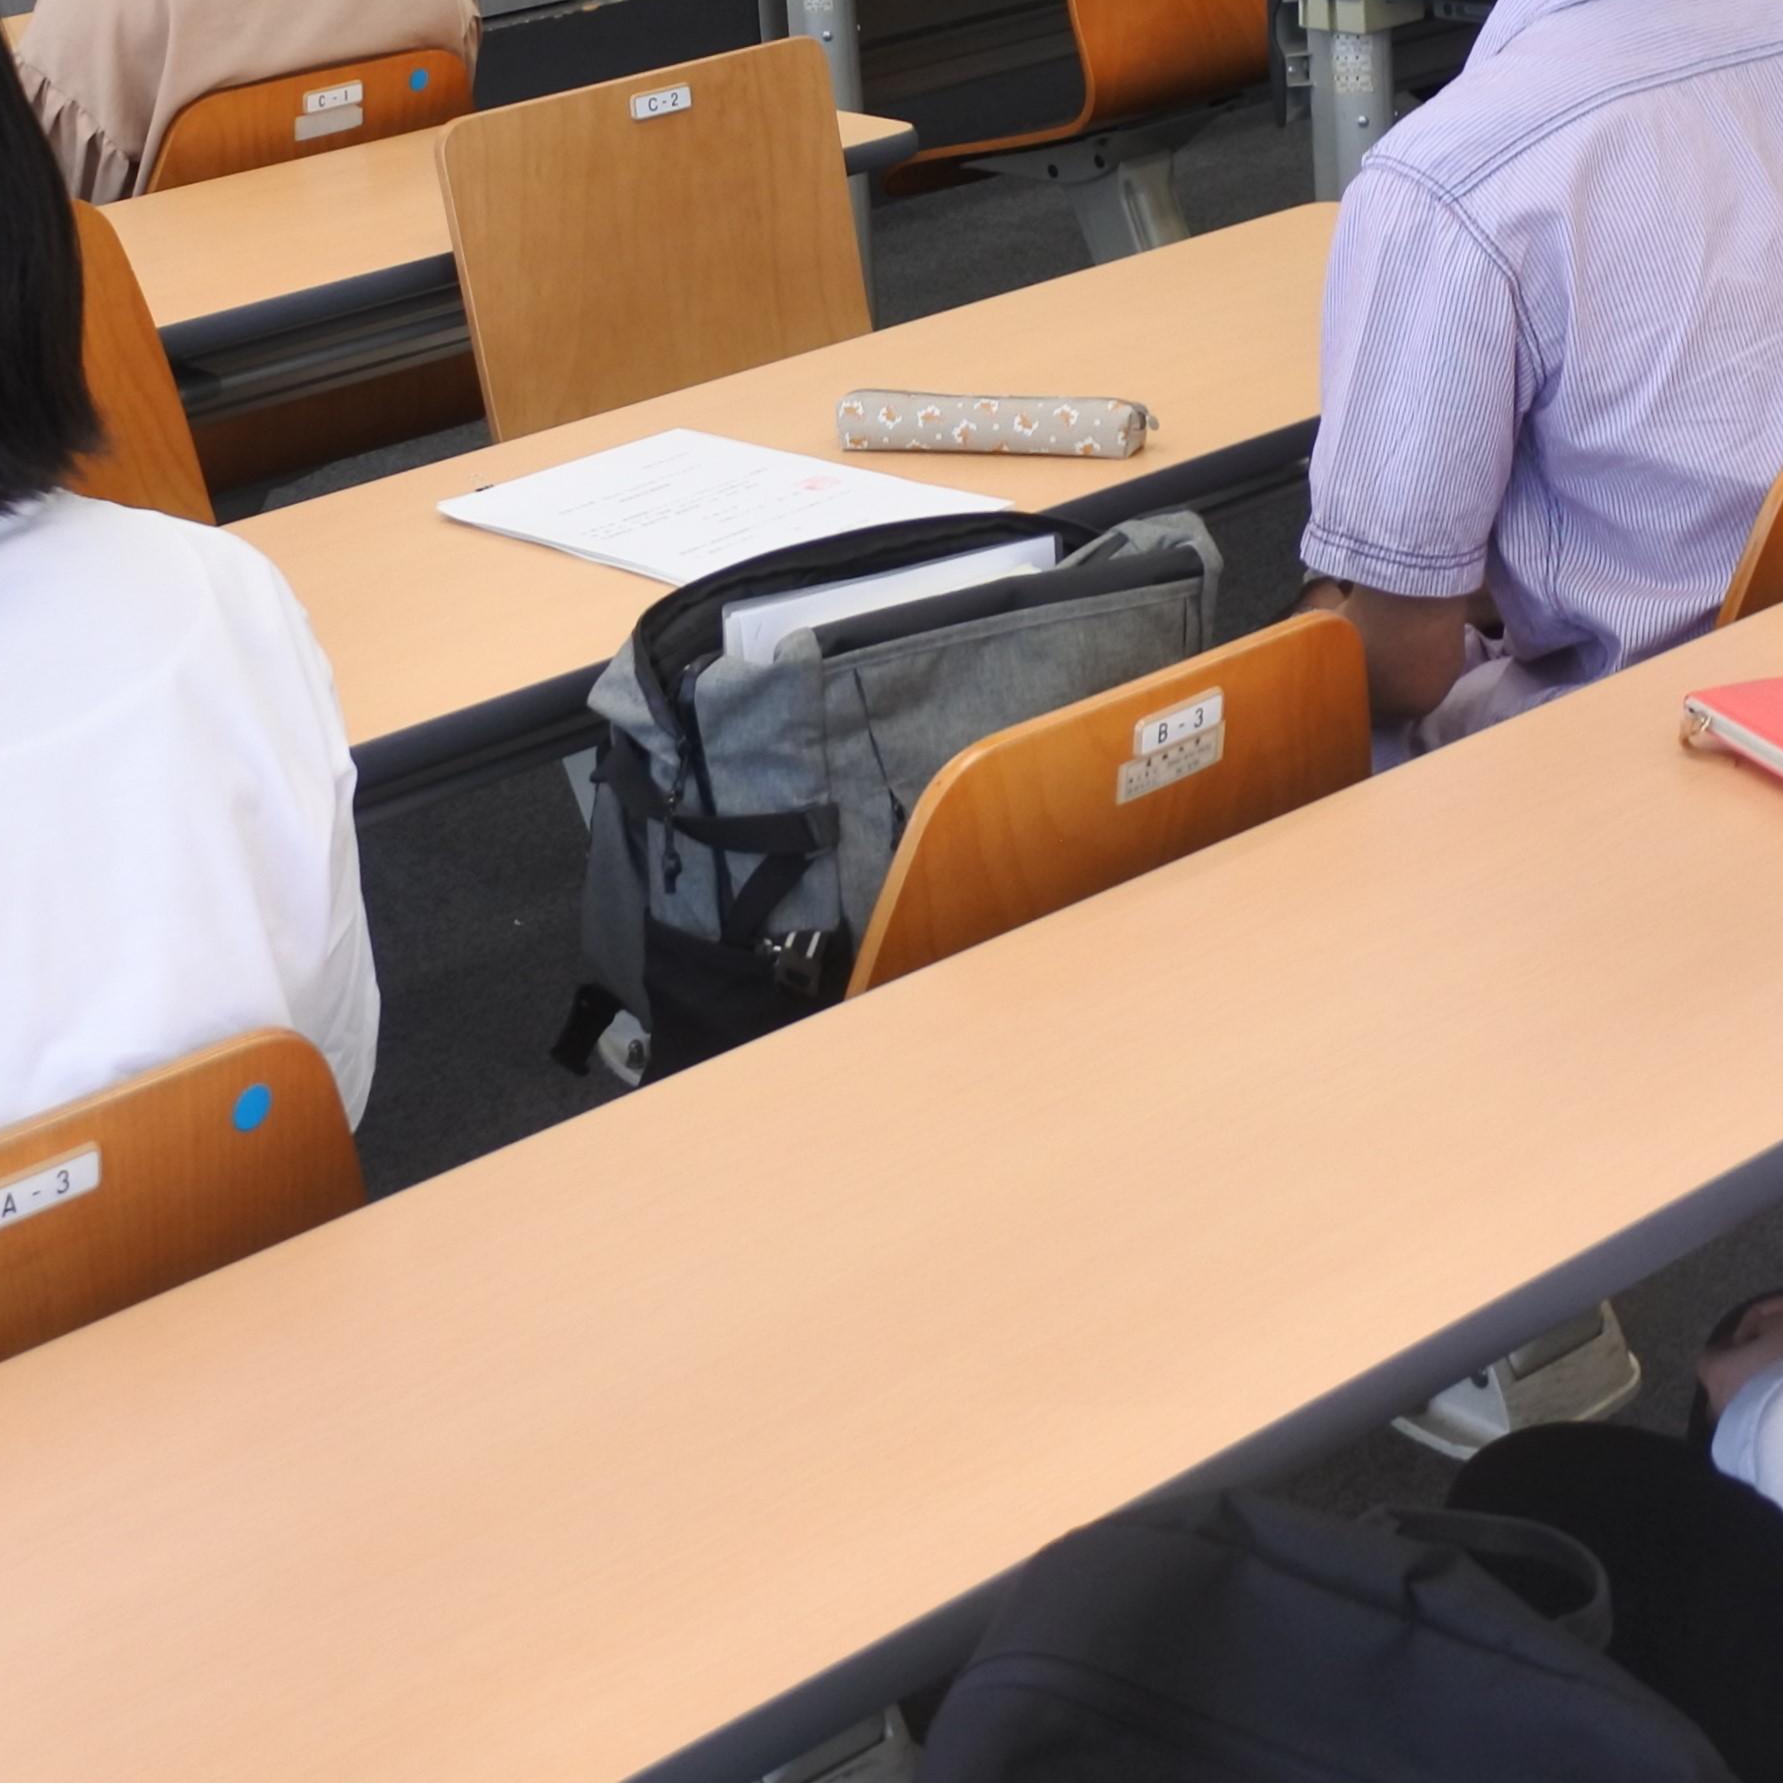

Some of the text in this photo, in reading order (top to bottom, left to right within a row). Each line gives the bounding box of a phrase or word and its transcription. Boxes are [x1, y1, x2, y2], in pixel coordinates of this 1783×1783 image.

[647, 91, 680, 112] C-2
[1157, 707, 1205, 744] B-3
[0, 1168, 71, 1219] A-3
